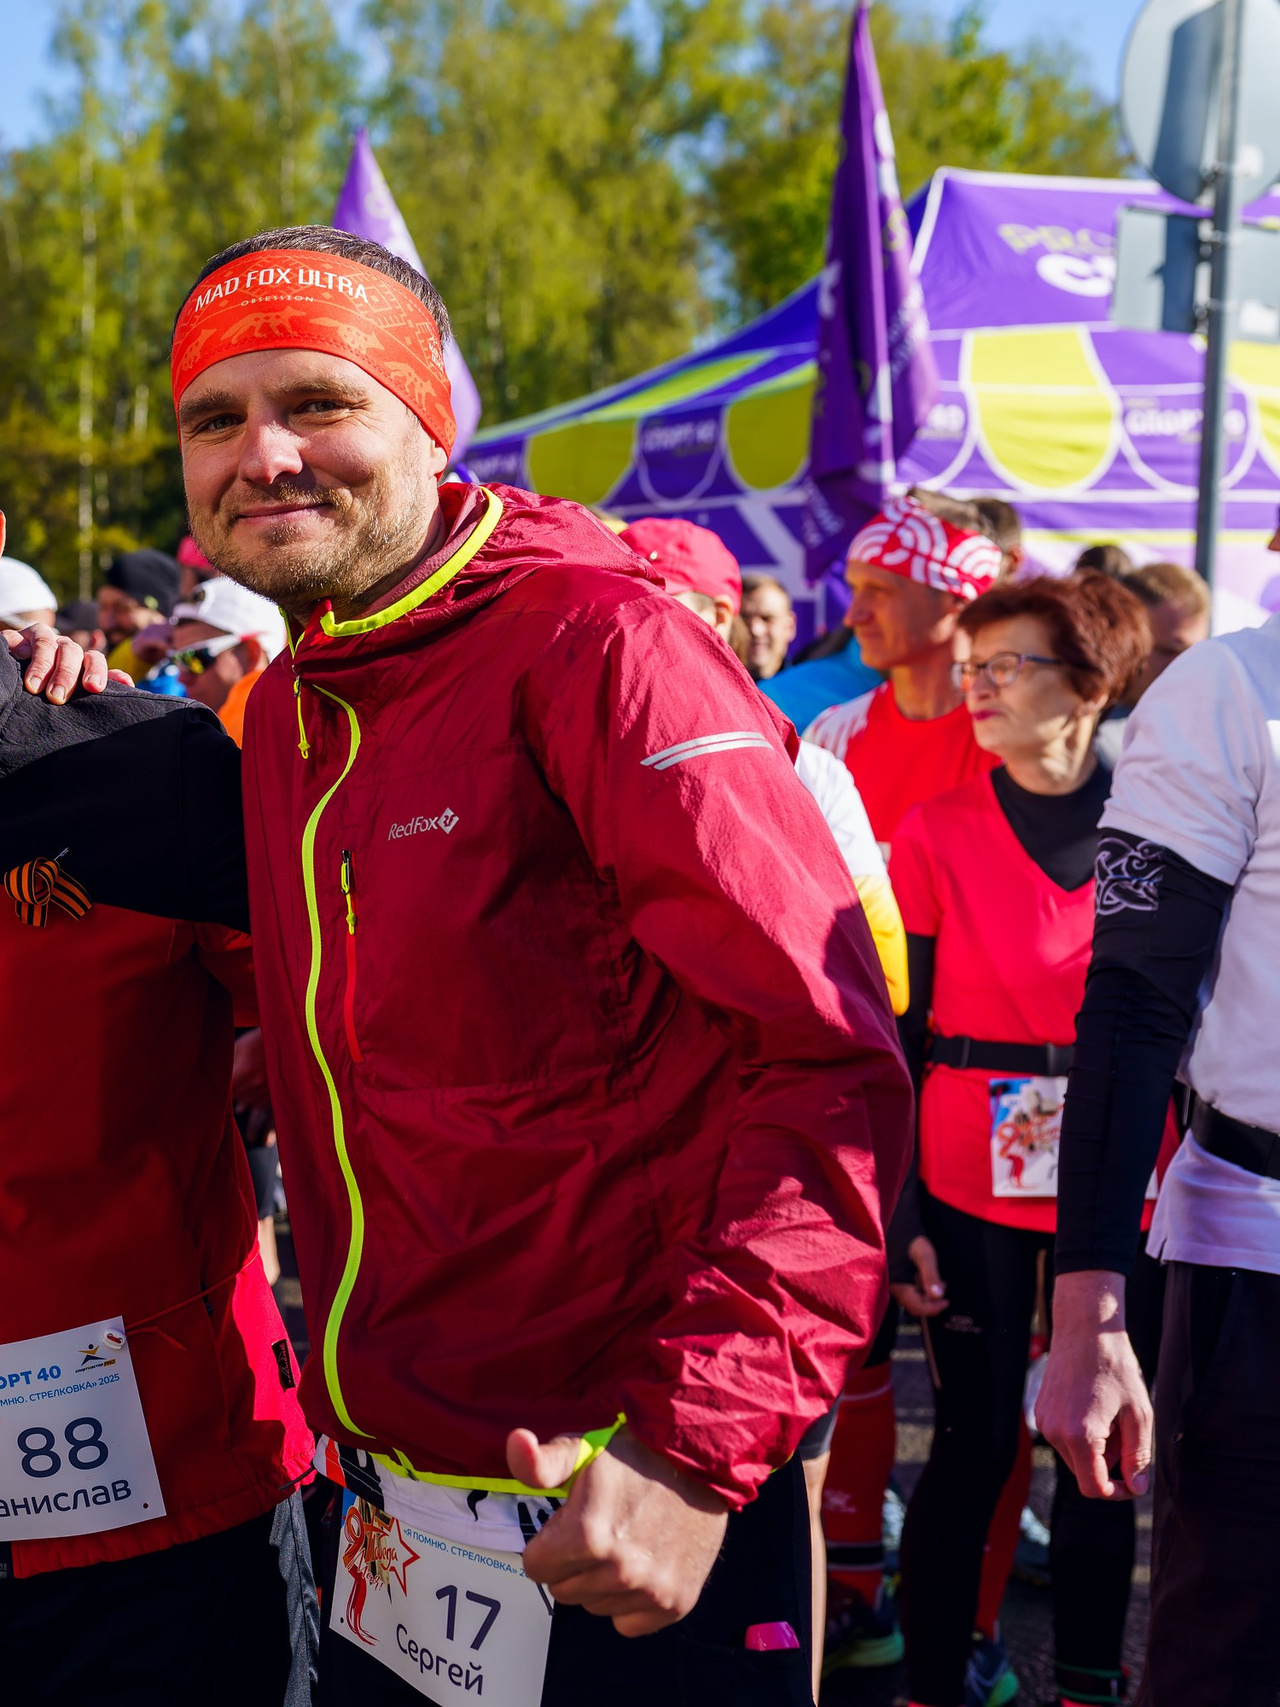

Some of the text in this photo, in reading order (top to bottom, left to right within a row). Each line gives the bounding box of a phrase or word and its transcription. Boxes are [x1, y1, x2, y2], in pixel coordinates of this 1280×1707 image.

[195, 267, 369, 312] MAD FOX ULTRA
[240, 294, 314, 307] OBSESSION
[387, 815, 439, 841] RedFox
[29, 1380, 97, 1402] СТРЕЛКОВКА»
[98, 1373, 120, 1386] 2025
[37, 1365, 62, 1382] 40
[16, 1416, 109, 1478] 88
[413, 1531, 449, 1552] ПОМНЮ.
[450, 1546, 518, 1575] СТРЕЛКОВКА»
[435, 1584, 502, 1652] 17
[396, 1623, 484, 1696] Сергей
